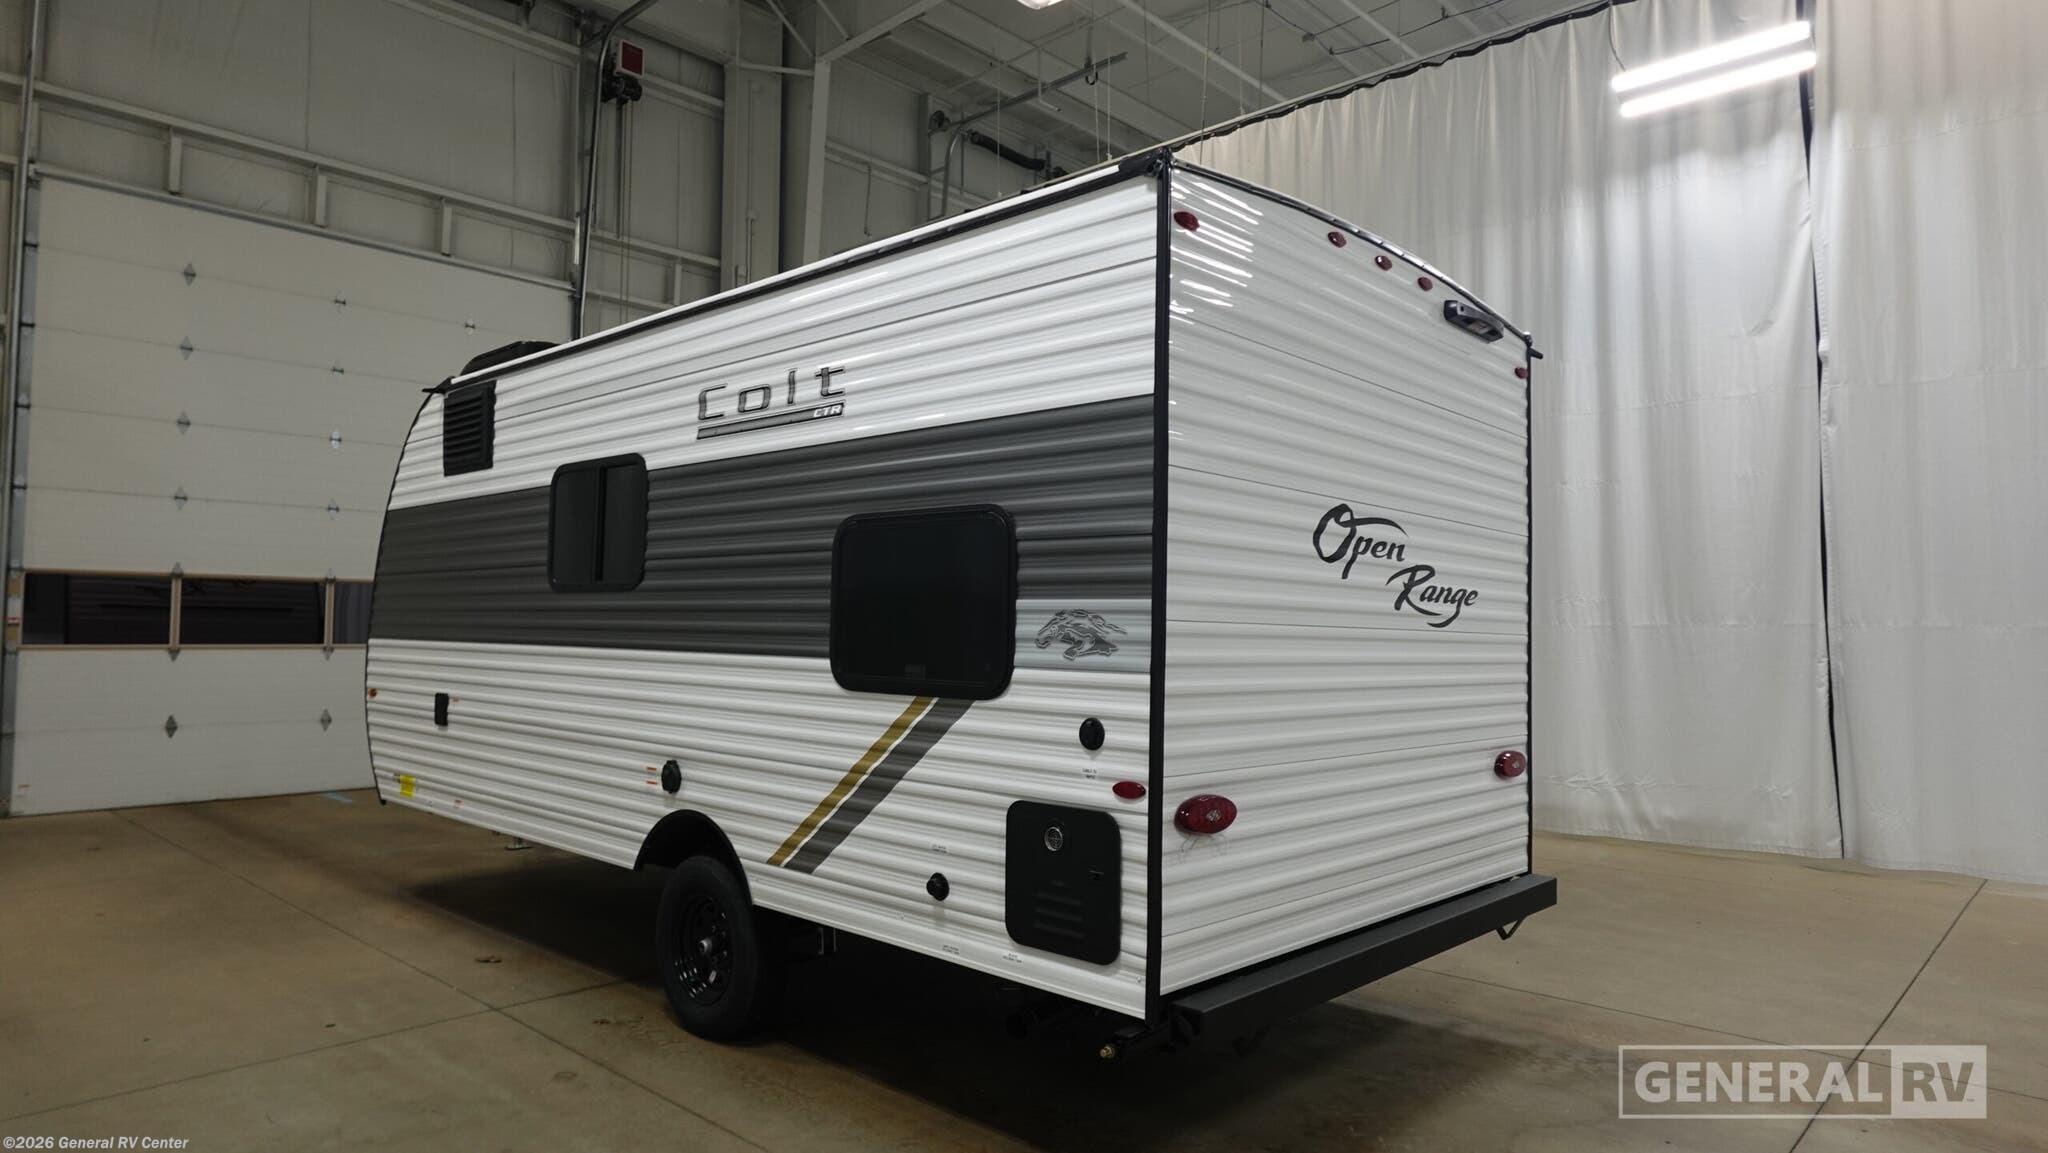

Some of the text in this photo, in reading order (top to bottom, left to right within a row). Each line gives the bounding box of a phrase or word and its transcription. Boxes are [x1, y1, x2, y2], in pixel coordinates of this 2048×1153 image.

[698, 366, 846, 421] Colt
[813, 405, 843, 418] CTR
[1312, 503, 1409, 580] Open
[1385, 564, 1479, 628] Range
